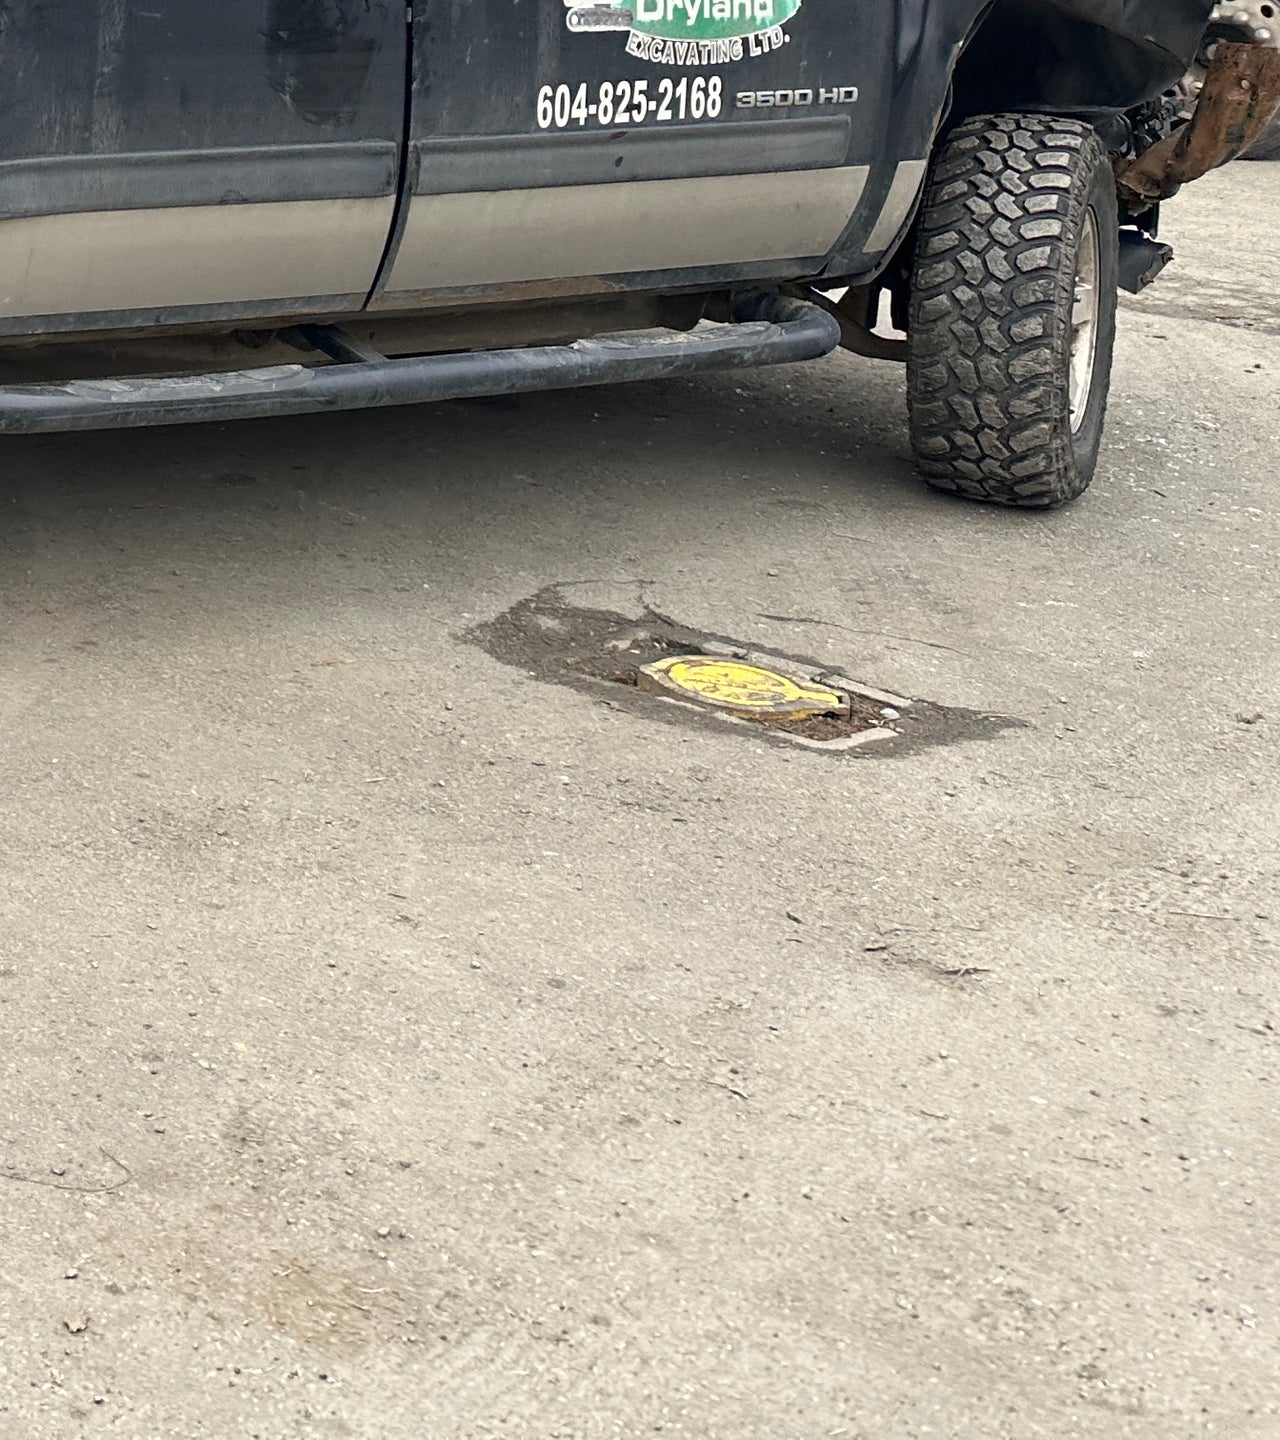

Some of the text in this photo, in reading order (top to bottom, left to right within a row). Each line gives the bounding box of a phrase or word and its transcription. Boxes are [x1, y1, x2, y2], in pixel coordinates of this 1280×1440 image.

[625, 24, 790, 66] EXCAVATING LTD.
[537, 75, 723, 129] 604-825-2168
[736, 87, 858, 109] 3500 HD
